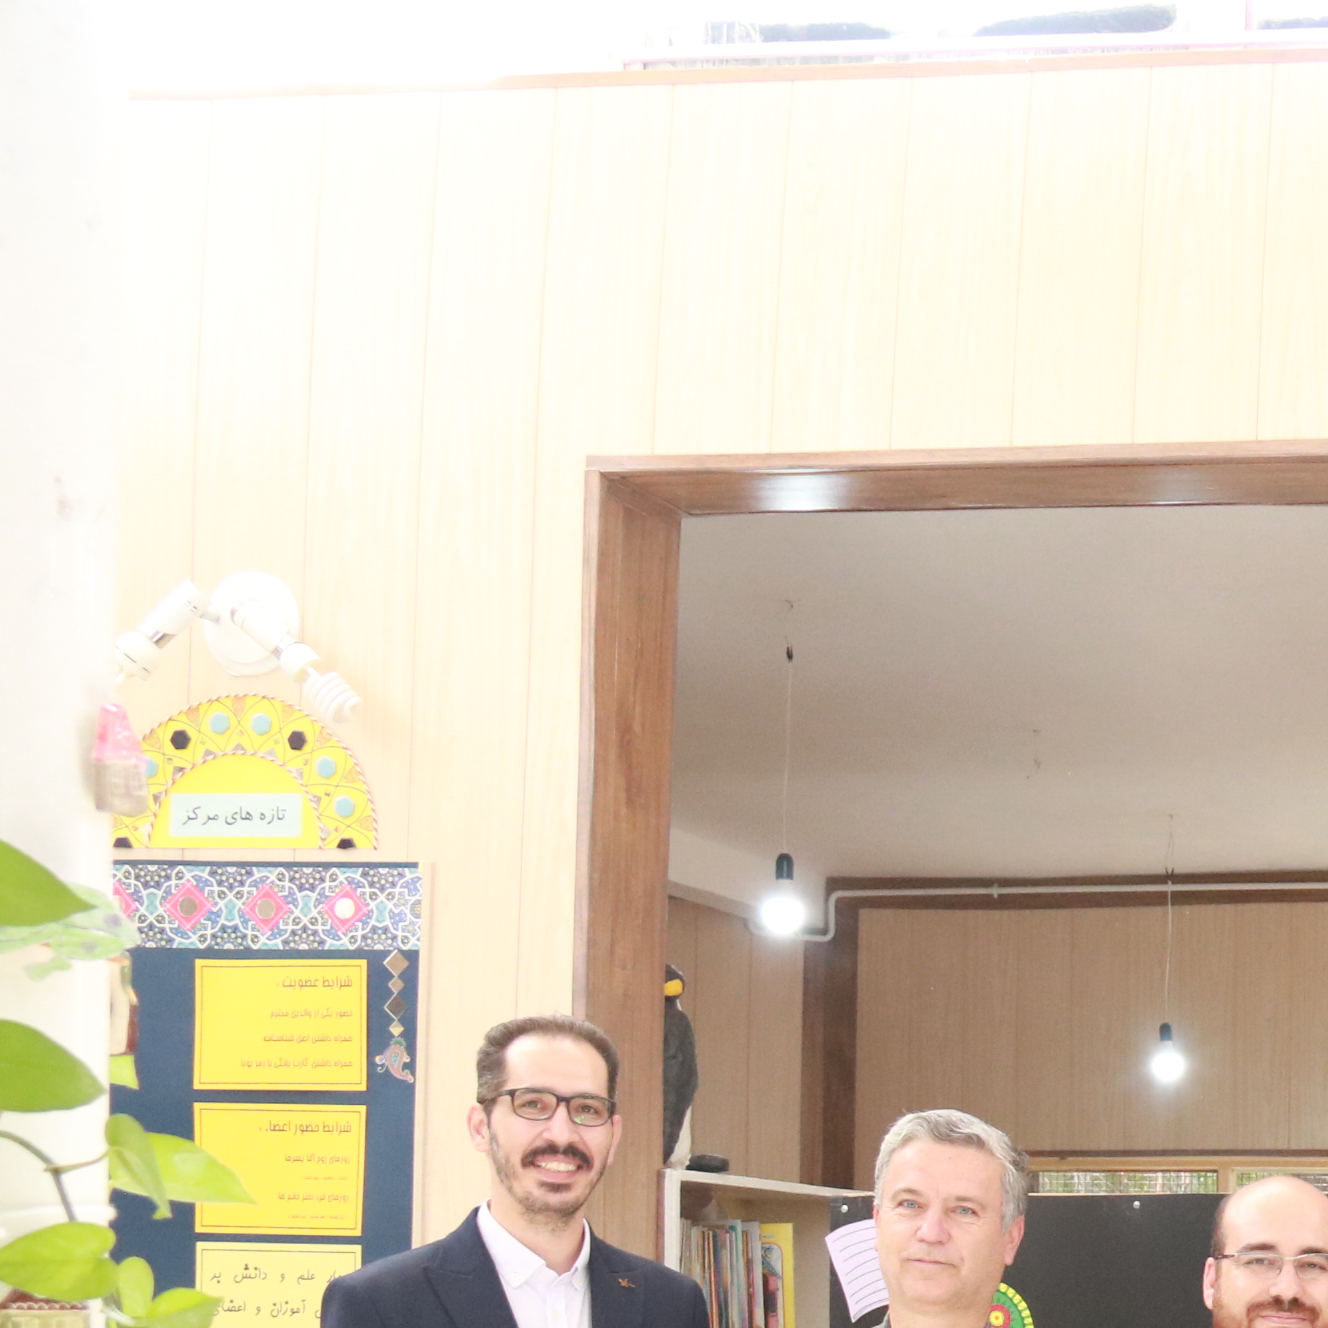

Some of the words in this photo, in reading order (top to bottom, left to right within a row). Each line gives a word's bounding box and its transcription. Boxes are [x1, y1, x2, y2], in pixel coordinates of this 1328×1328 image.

[181, 803, 219, 826] مرکز
[223, 805, 254, 826] های
[259, 807, 287, 824] تازه
[321, 975, 353, 990] شرایط
[294, 1121, 320, 1136] حضور
[321, 1120, 352, 1136] شرایط
[233, 1262, 268, 1284] دانش
[279, 1272, 286, 1283] و
[296, 1268, 316, 1285] علم
[255, 1305, 262, 1317] و
[270, 1299, 307, 1318] آموزان
